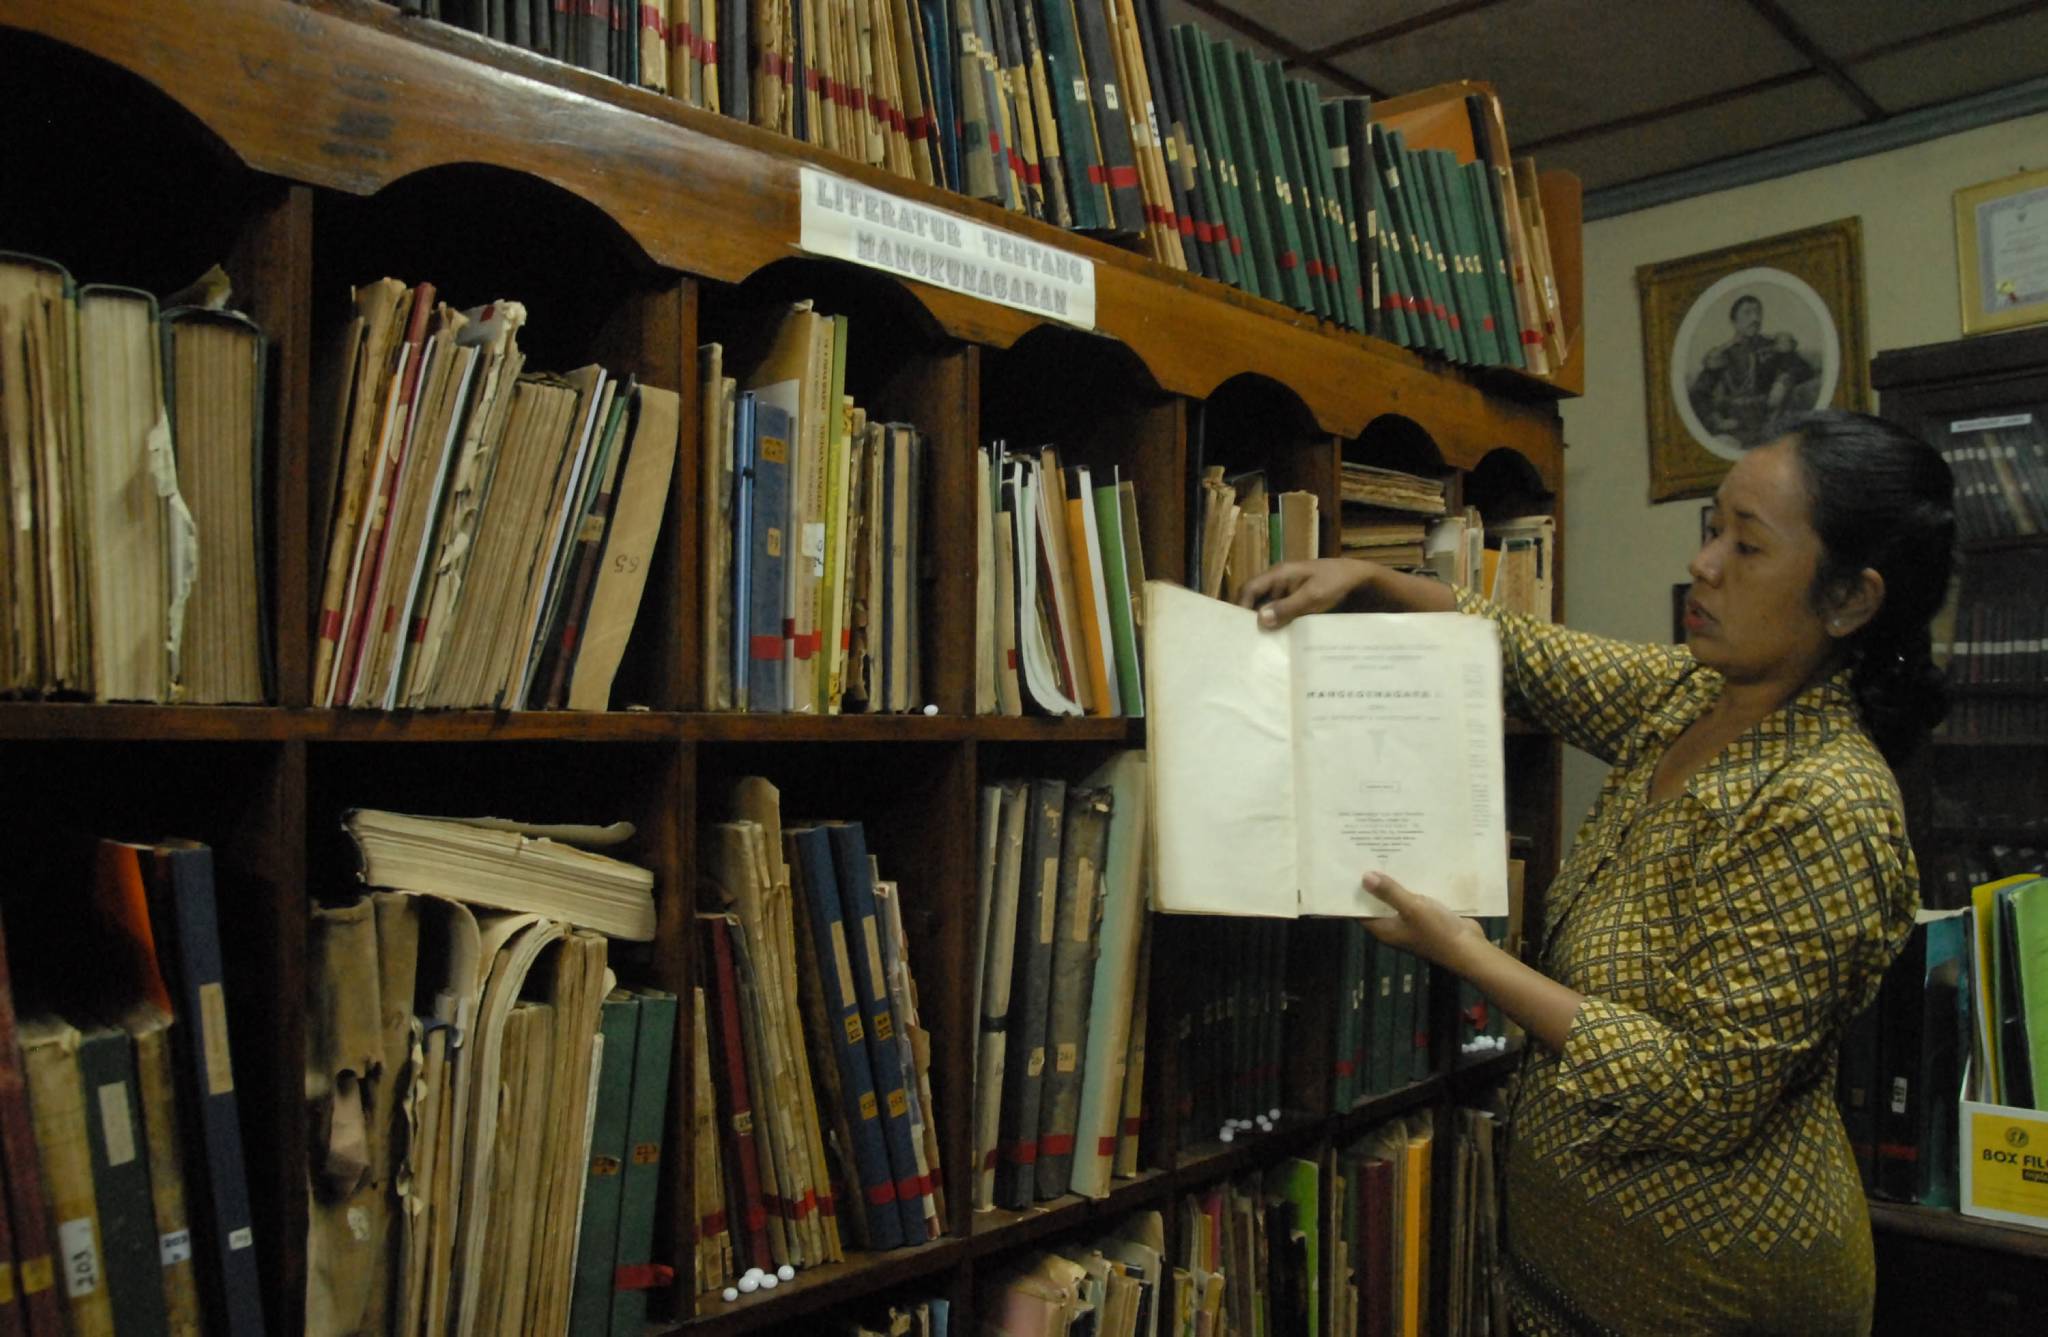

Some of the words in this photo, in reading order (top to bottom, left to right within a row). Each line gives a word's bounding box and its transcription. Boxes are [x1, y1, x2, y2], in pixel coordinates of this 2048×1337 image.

[815, 176, 963, 250] LITERATUR
[982, 228, 1085, 285] TENTANG
[856, 230, 1069, 316] MANGKUNAGARAN
[1983, 1148, 2018, 1165] BOX
[2023, 1154, 2048, 1169] FIL
